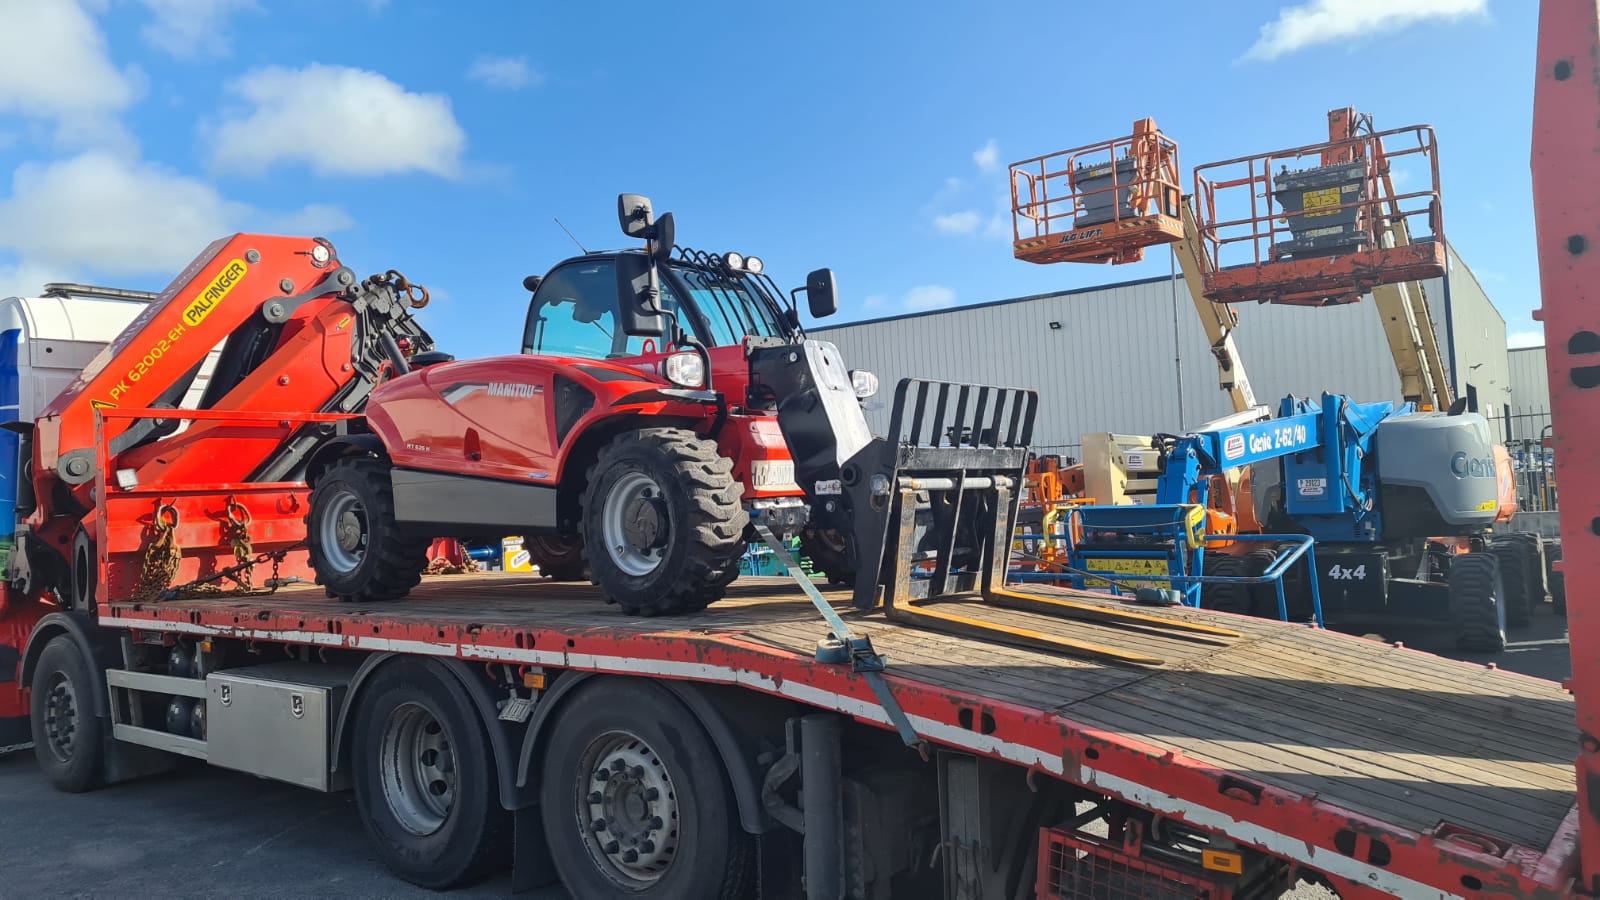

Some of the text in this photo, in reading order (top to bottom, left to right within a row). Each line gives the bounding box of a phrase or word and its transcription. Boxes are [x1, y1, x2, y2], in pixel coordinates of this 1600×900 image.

[1059, 229, 1102, 243] JLG LIFT
[186, 262, 245, 323] PALFINGER
[109, 323, 186, 400] PK 62002-EH
[487, 382, 536, 398] MANITOU
[1249, 432, 1272, 454] Genie
[1274, 424, 1306, 448] Z-62/40
[1328, 564, 1367, 580] 4x4
